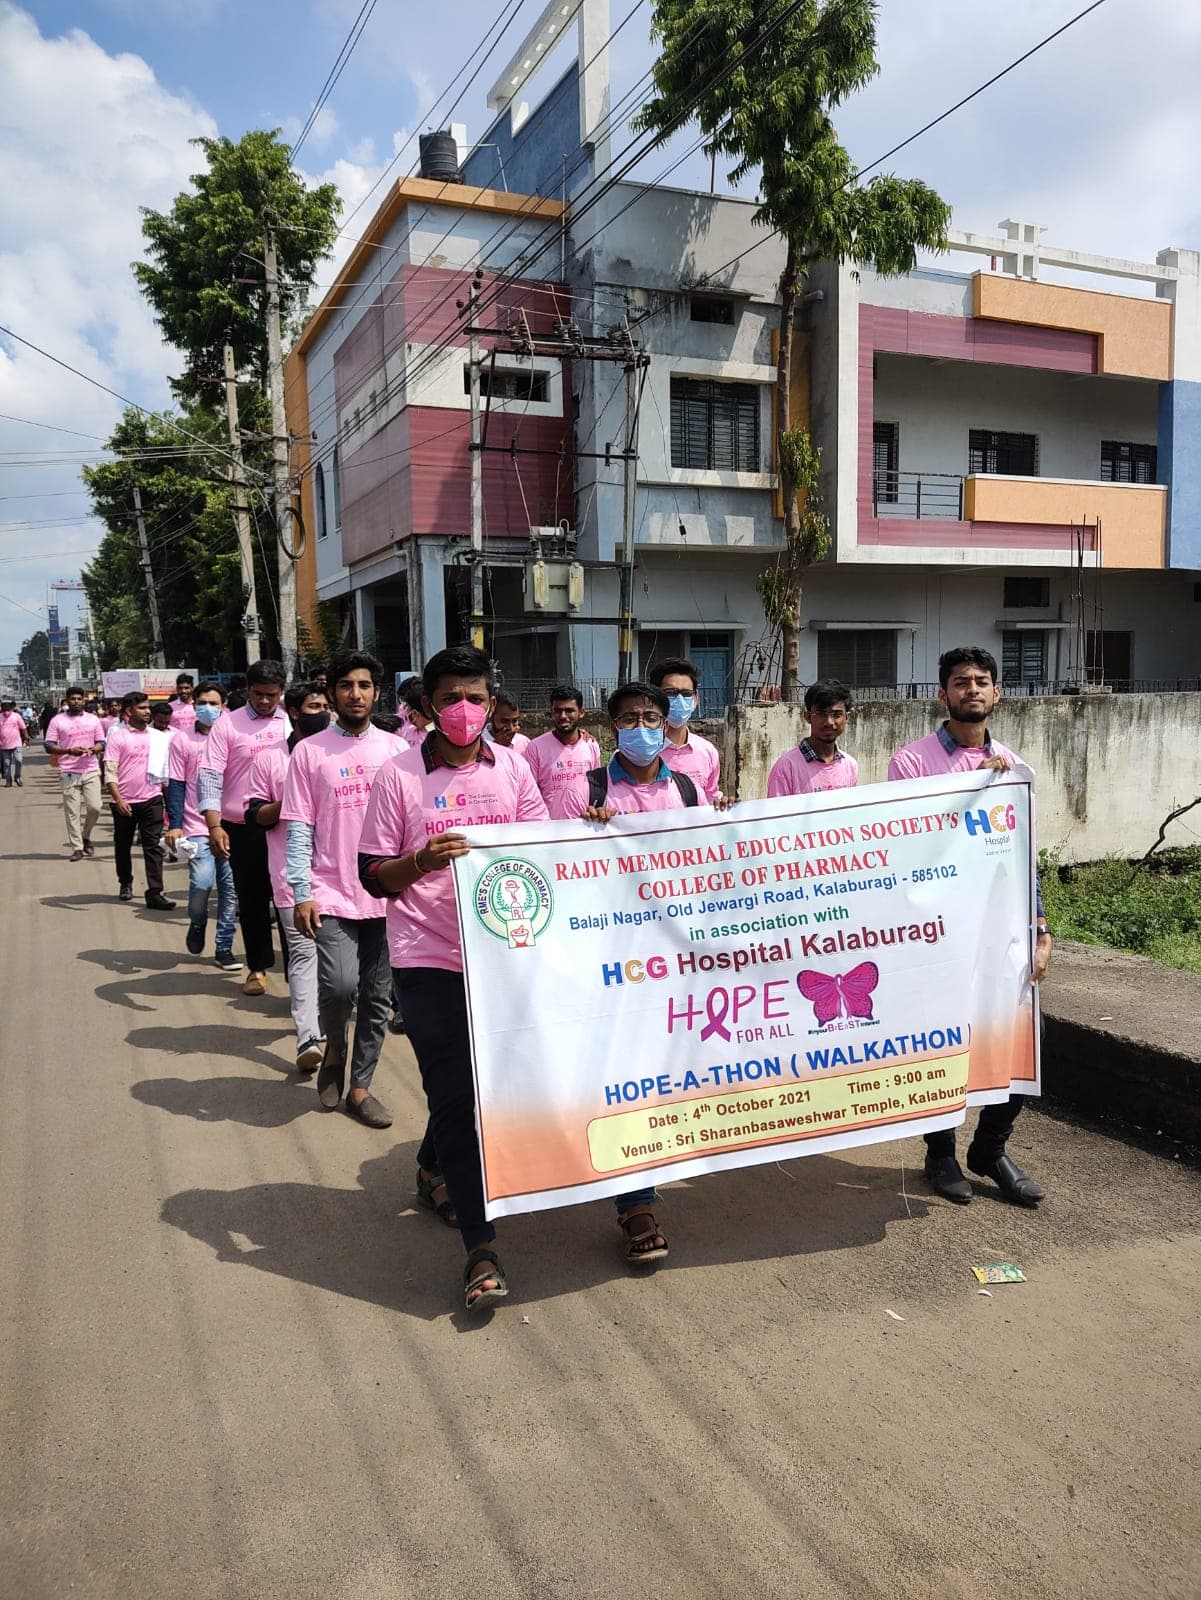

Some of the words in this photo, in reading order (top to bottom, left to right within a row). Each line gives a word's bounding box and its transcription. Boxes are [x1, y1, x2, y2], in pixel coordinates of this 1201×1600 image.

[255, 732, 273, 740] HG
[340, 765, 364, 777] HCG
[434, 792, 466, 808] HCG
[965, 804, 1016, 836] HCG
[555, 858, 611, 881] RAJIV
[617, 844, 732, 875] MEMORIAL
[735, 826, 855, 858] EDUCATION
[859, 811, 959, 842] SOCIETY'S
[985, 834, 1010, 847] Hospial
[482, 863, 512, 887] COLLEGE
[513, 862, 524, 872] OF
[637, 871, 736, 901] COLLEGE
[741, 866, 768, 887] OF
[775, 849, 889, 882] PHARMACY
[477, 887, 489, 915] RME'S
[524, 867, 549, 910] PHARMACY
[569, 913, 609, 932] Balaji
[612, 908, 663, 927] Nagar,
[666, 902, 693, 919] Old
[698, 894, 759, 914] Jewargi
[763, 886, 809, 905] Road,
[813, 872, 898, 897] Kalaburagi
[911, 864, 958, 884] 585102
[689, 926, 706, 942] in
[710, 911, 809, 940] association
[812, 905, 850, 923] with
[601, 956, 669, 986] HCG
[676, 937, 793, 976] Hospital
[800, 914, 945, 958] Kalaburagi
[667, 979, 790, 1044] HOPE
[736, 1028, 765, 1045] FOR
[769, 1023, 795, 1040] ALL
[605, 1056, 782, 1106] HOPE-A-THON
[805, 1026, 962, 1070] WALKATHON
[847, 1078, 882, 1096] Time
[893, 1069, 923, 1086] 9:00
[926, 1068, 946, 1081] am
[648, 1113, 679, 1129] Date
[692, 1103, 711, 1120] 4th
[716, 1095, 775, 1117] October
[779, 1089, 812, 1107] 2021
[621, 1139, 664, 1158] Venue
[675, 1131, 695, 1148] Sri
[700, 1107, 848, 1142] Sharanbasaweshwar
[851, 1095, 906, 1117] Temple,
